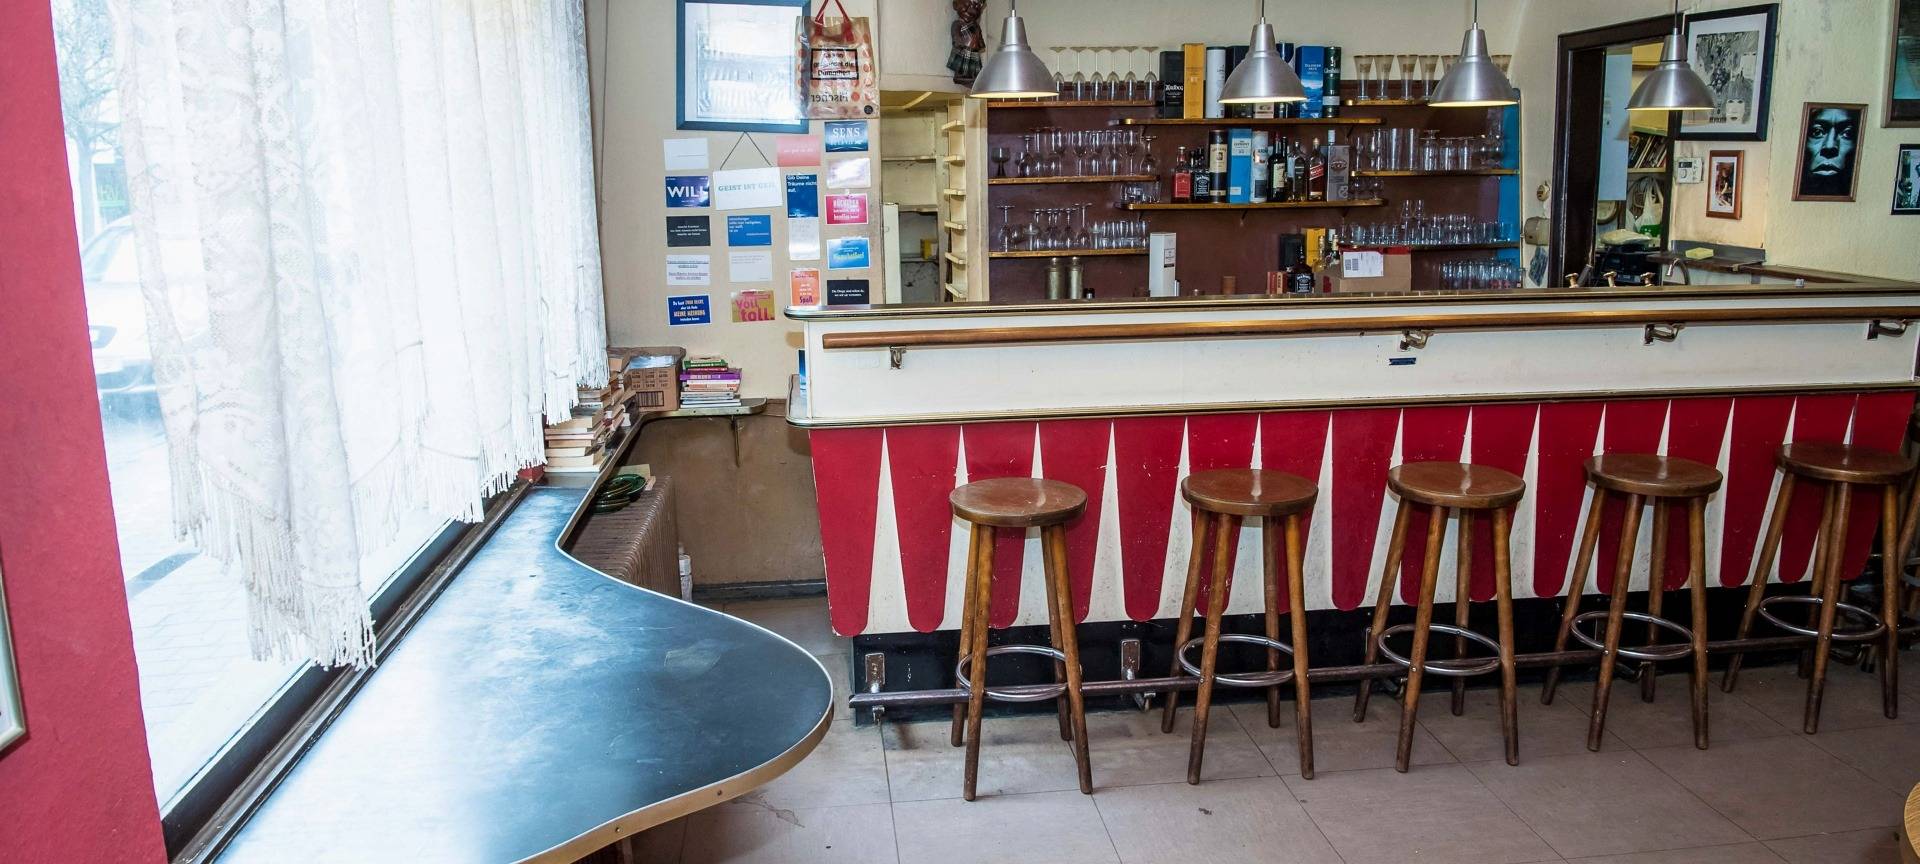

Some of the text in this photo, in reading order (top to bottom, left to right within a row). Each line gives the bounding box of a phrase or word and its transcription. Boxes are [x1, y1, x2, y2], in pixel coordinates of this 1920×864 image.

[832, 127, 861, 137] SENS
[718, 184, 743, 192] GEIST
[740, 307, 776, 321] toll.
